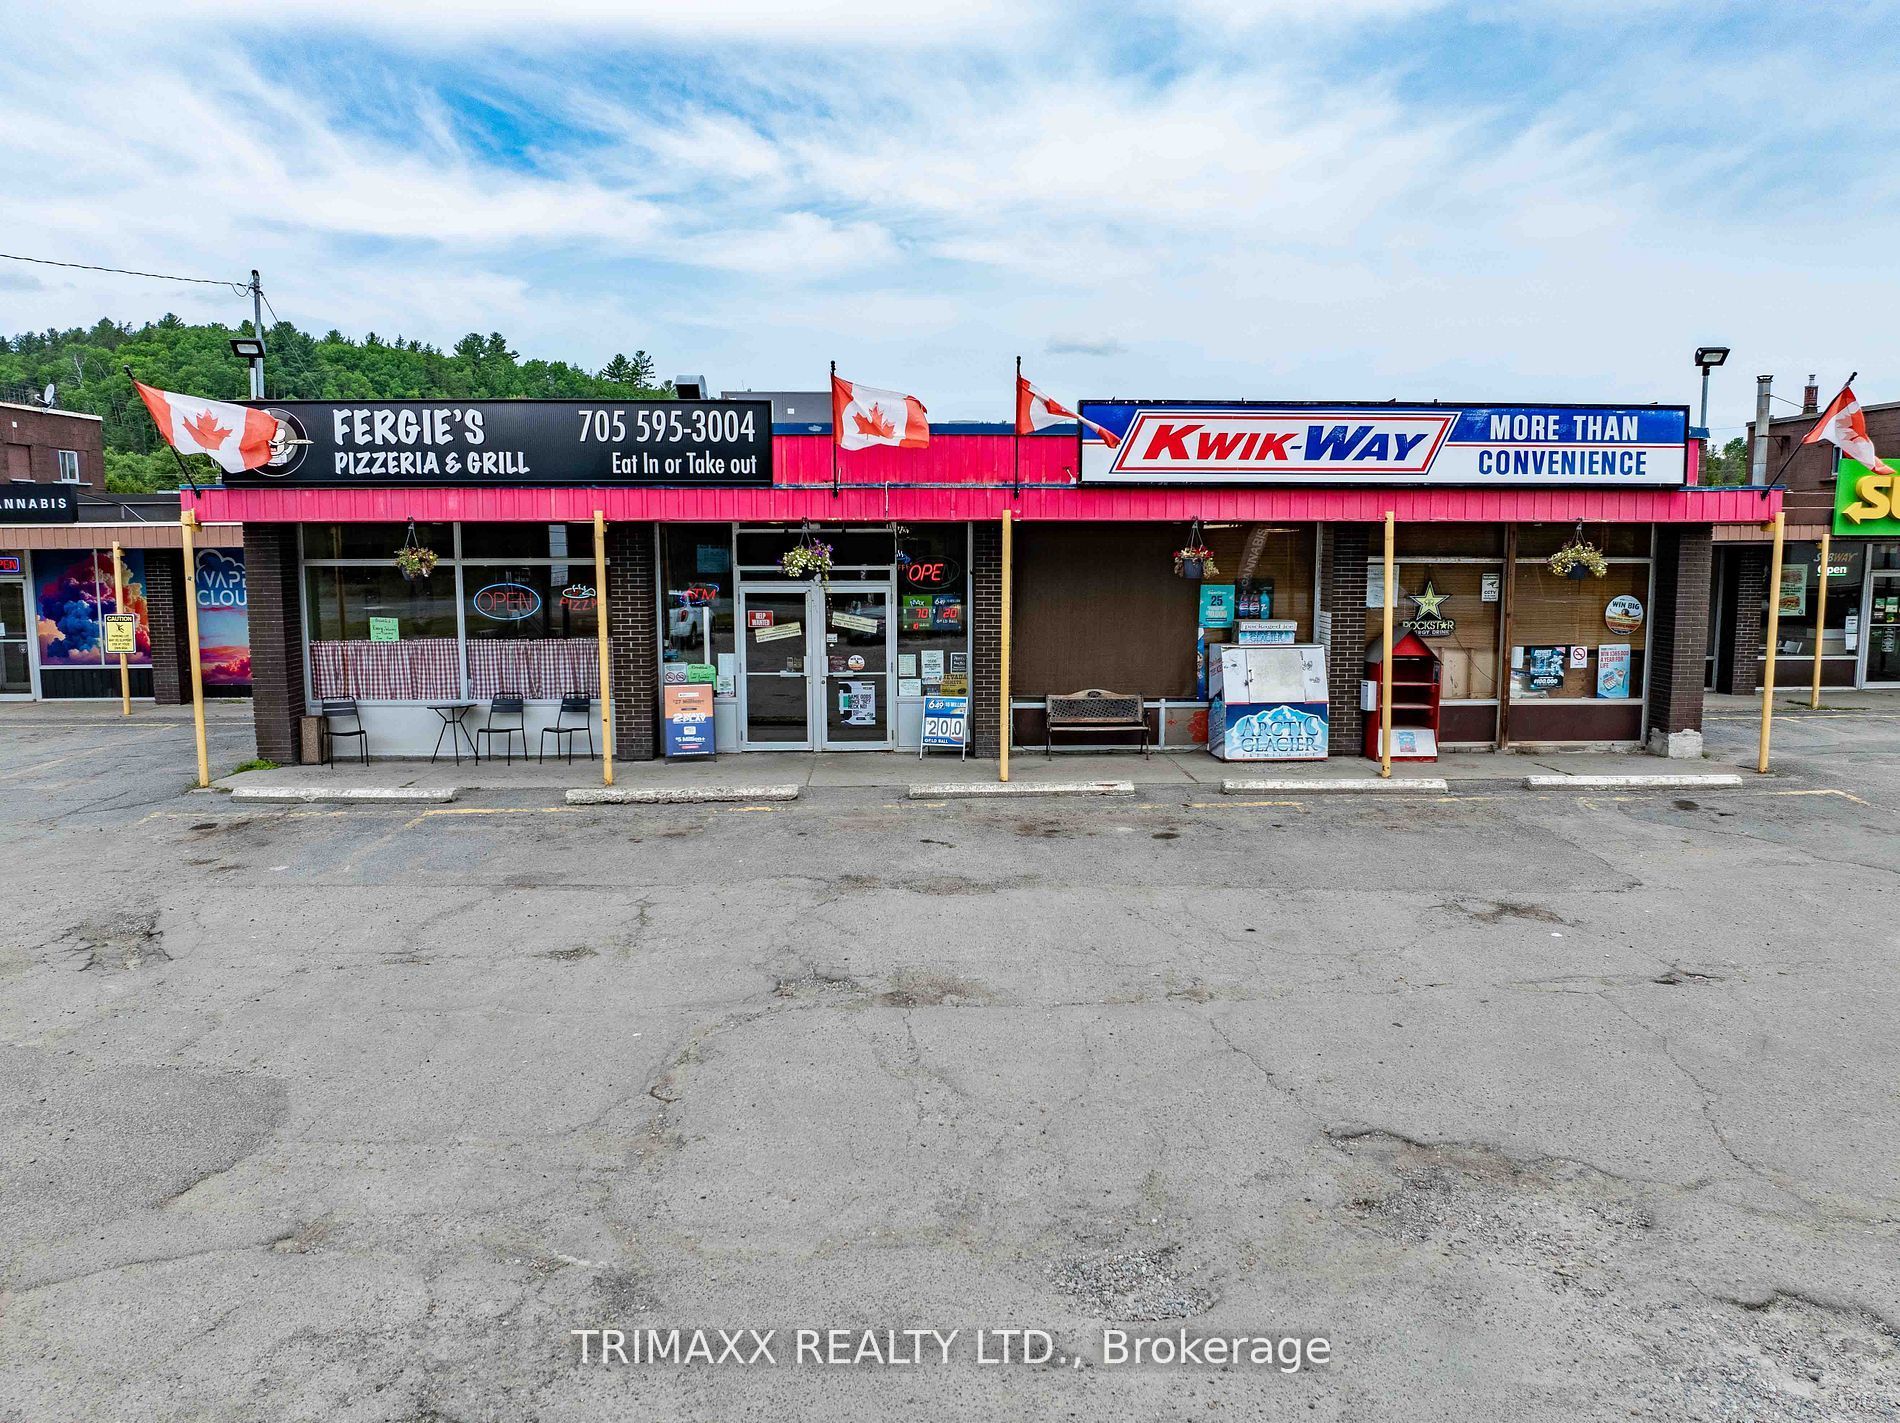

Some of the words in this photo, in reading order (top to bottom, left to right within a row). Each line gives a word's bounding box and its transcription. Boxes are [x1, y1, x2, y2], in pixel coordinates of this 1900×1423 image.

[333, 408, 485, 446] FERGIE'S
[578, 410, 626, 442] 705
[636, 410, 756, 443] 595-3004
[1490, 415, 1559, 440] MORE
[1573, 416, 1638, 441] THAN
[335, 452, 440, 475] PIZZERIA
[445, 451, 462, 474] &
[467, 452, 530, 474] GRILL
[612, 452, 637, 474] Eat
[643, 452, 659, 474] In
[664, 456, 682, 474] or
[686, 451, 725, 474] Take
[730, 455, 757, 474] out
[1478, 450, 1646, 476] CONVENIENCE
[0, 498, 67, 509] NNABIS
[1841, 475, 1900, 525] S
[1813, 552, 1858, 562] SBWAY
[478, 591, 533, 612] OPEN
[1210, 595, 1223, 606] 25
[1627, 602, 1640, 610] BIG
[916, 608, 929, 618] 70
[943, 608, 958, 618] 20
[1241, 716, 1320, 737] ARCTIC
[1241, 737, 1318, 753] GLACIER
